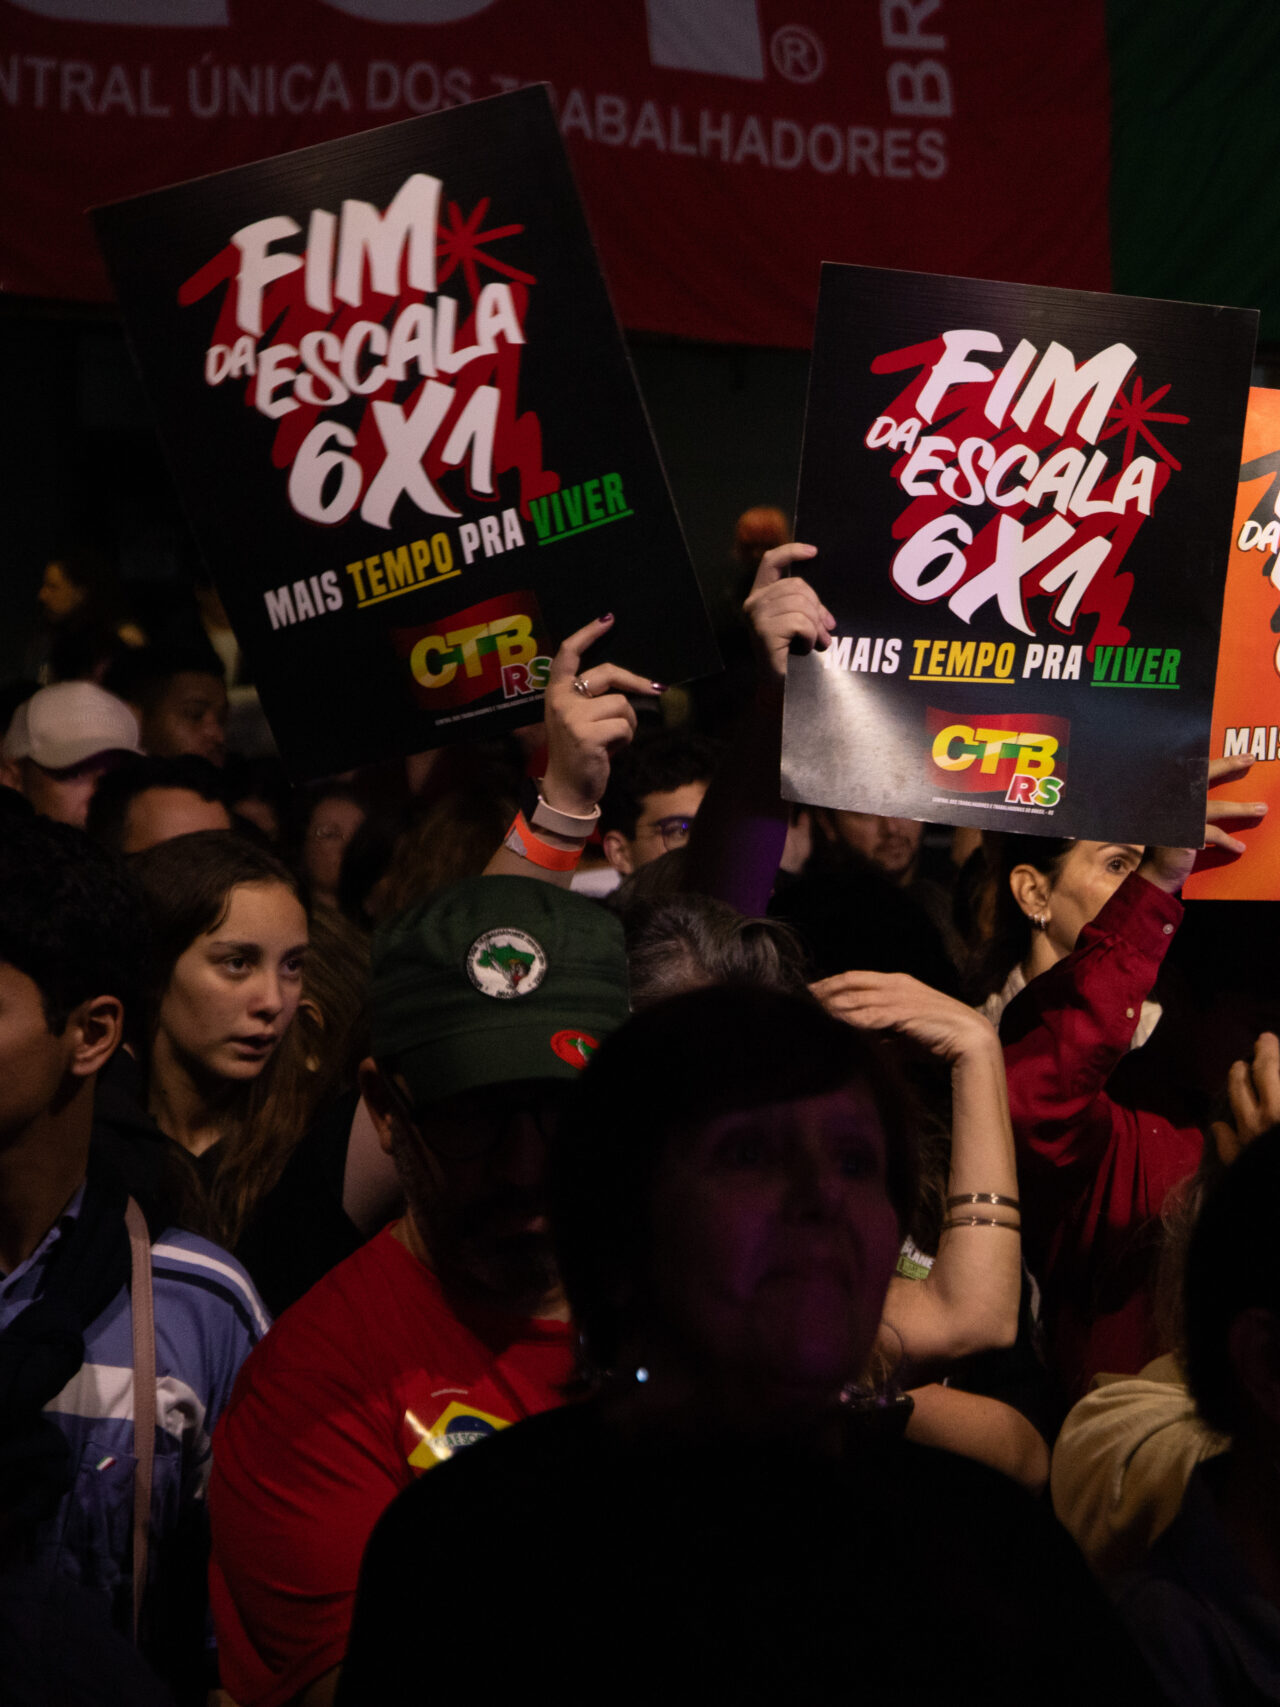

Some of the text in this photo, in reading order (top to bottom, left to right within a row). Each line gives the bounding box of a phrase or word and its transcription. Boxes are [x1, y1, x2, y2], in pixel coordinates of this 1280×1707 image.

[187, 50, 352, 120] ÚNICA
[365, 59, 473, 115] DOS
[490, 73, 949, 181] ABALHADORES
[232, 173, 443, 336] FIM
[205, 282, 528, 420] DA ESCALA
[916, 329, 1137, 446] FIM
[289, 379, 501, 530] 6X1
[865, 416, 1157, 517] DA ESCALA
[263, 471, 628, 631] MAIS TEMPO PRA VIVER
[892, 513, 1112, 637] 6X1
[410, 614, 538, 689] CTB
[501, 656, 553, 699] RS
[823, 636, 1181, 684] MAIS TEMPO PRA VIVER
[932, 724, 1059, 780] CTB
[1005, 773, 1064, 807] RS
